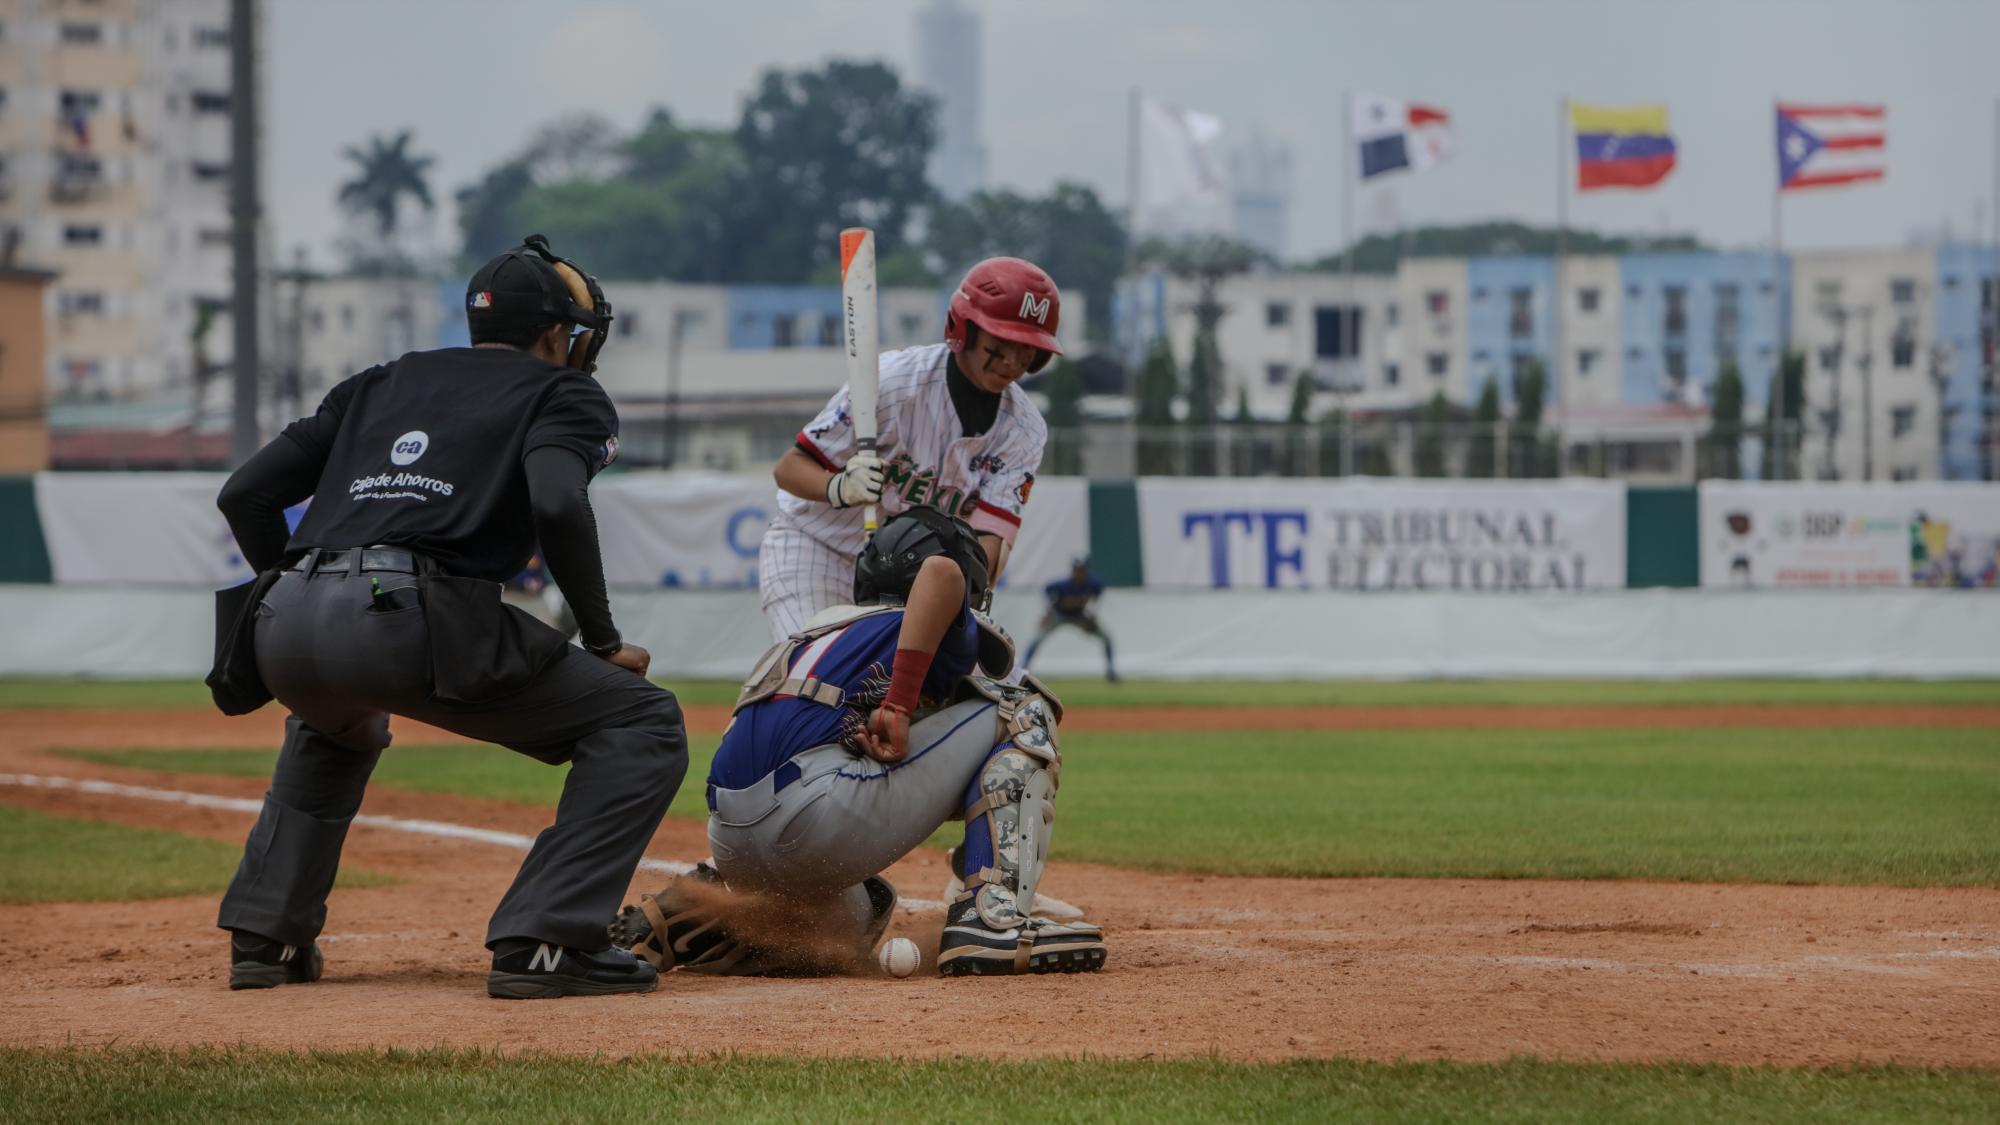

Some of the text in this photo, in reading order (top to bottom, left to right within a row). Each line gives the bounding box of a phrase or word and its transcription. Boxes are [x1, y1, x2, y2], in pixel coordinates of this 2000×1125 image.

[1019, 291, 1050, 325] M
[847, 296, 857, 357] EASTON
[395, 441, 422, 454] ca
[391, 472, 454, 496] Ahorros
[1328, 509, 1567, 545] TRIBUNAL
[1327, 549, 1588, 591] ELECTORAL
[528, 943, 563, 972] N
